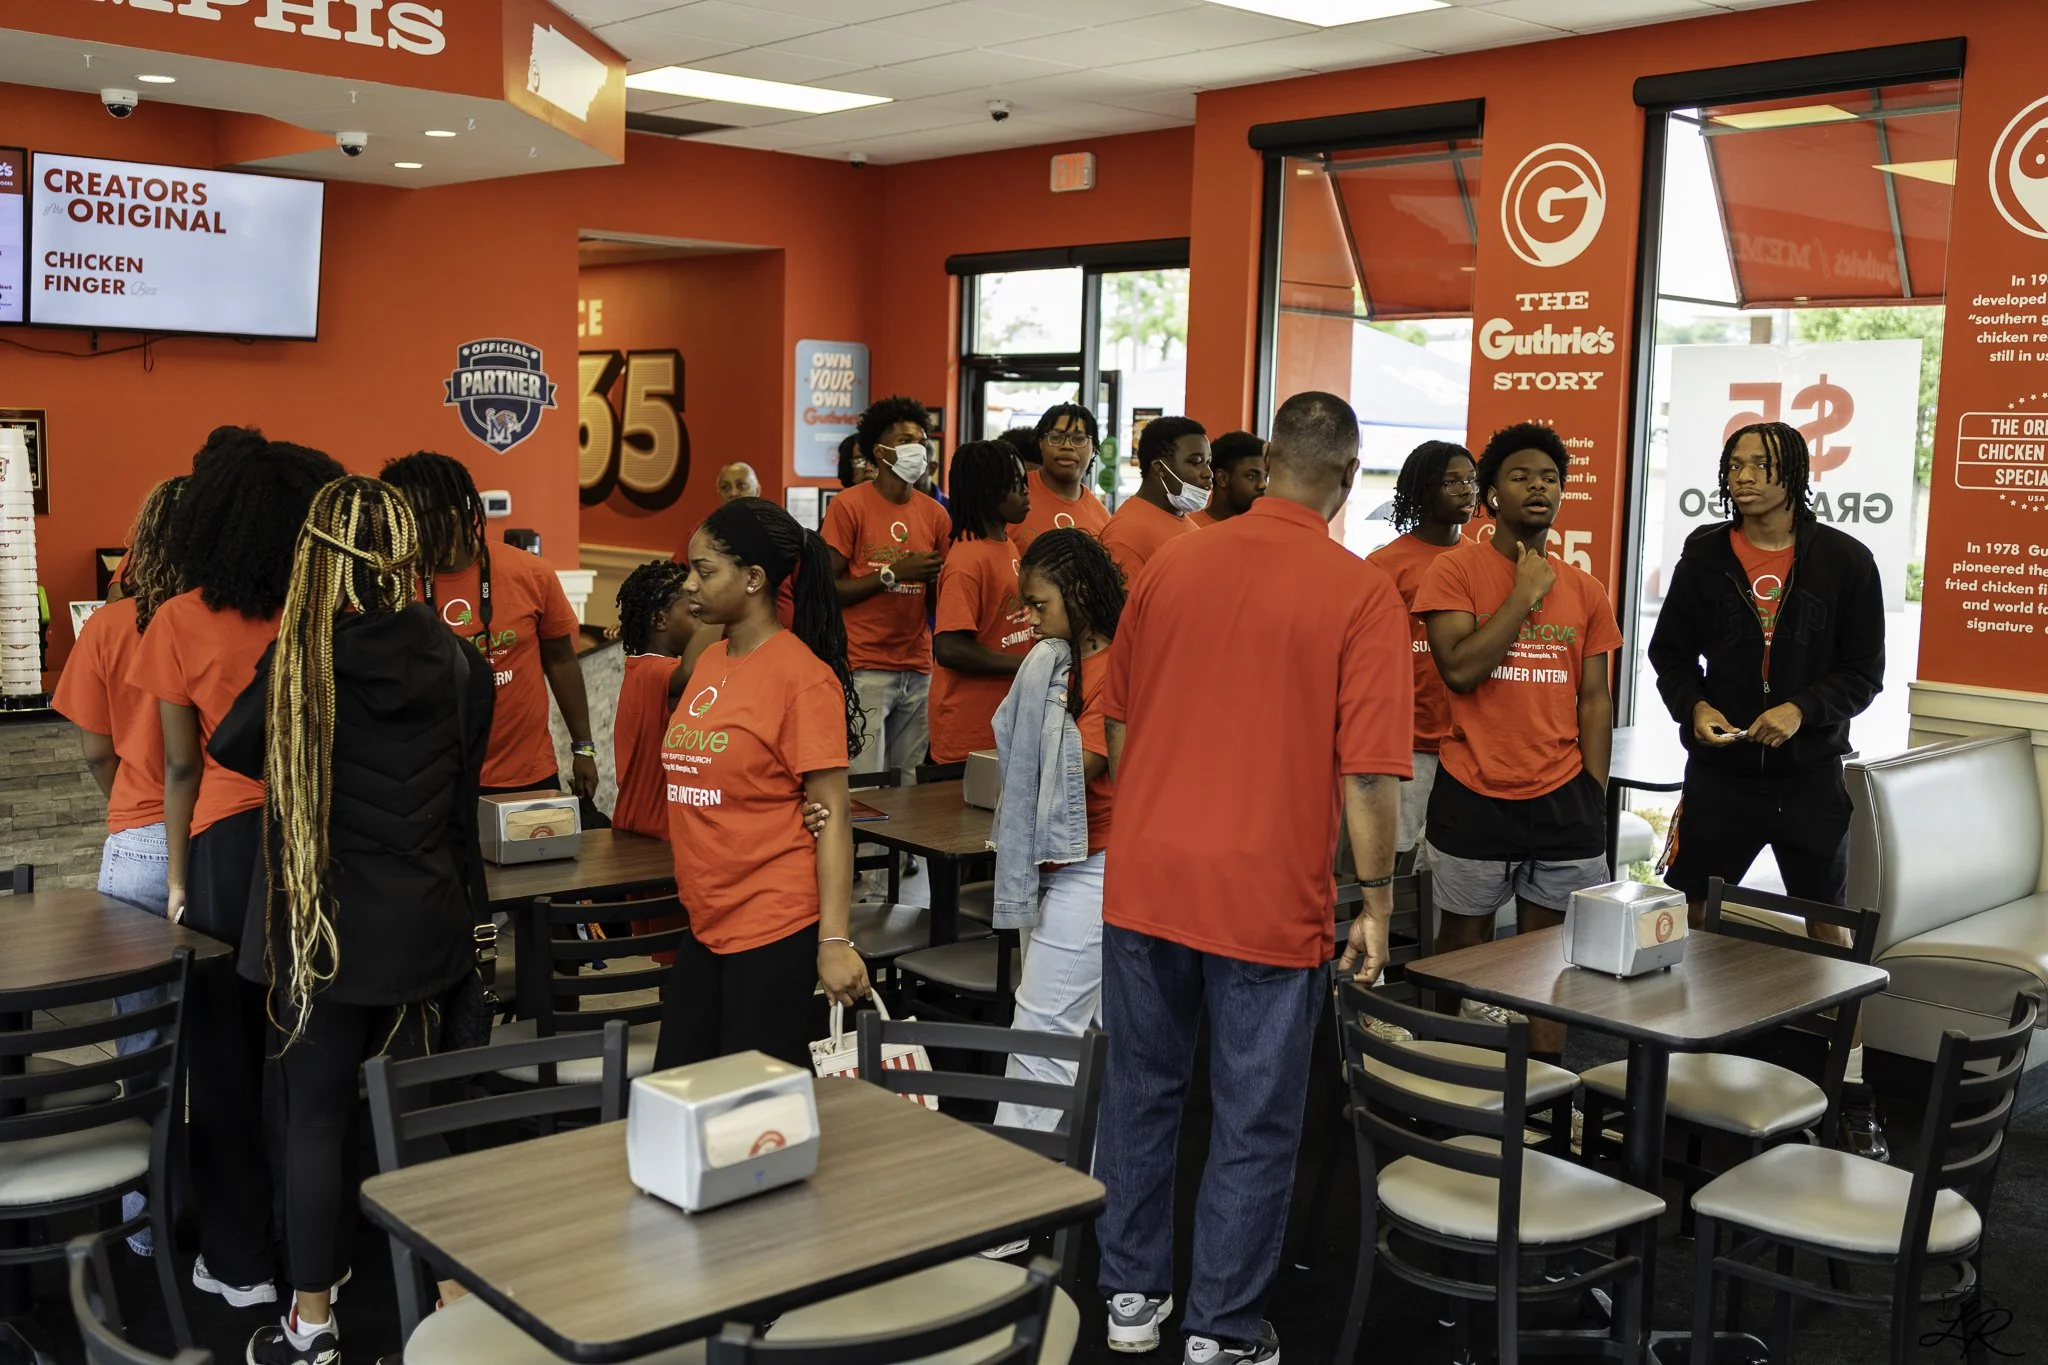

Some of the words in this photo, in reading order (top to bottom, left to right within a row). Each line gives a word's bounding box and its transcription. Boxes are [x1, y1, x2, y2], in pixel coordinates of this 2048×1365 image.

[43, 168, 208, 206] CREATORS
[67, 198, 227, 234] ORIGINAL
[44, 251, 143, 273] CHICKEN
[44, 275, 125, 295] FINGER
[2011, 275, 2025, 286] In
[2031, 274, 2048, 286] 19
[1516, 291, 1589, 311] THE
[1972, 292, 2047, 308] developed
[1479, 318, 1615, 360] Guthrie's
[1976, 331, 2028, 343] chicken
[471, 343, 529, 356] OFFICIAL
[1989, 350, 2014, 362] still
[2018, 350, 2032, 361] in
[812, 352, 853, 368] OWN
[461, 370, 541, 399] PARTNER
[810, 368, 856, 391] YOUR
[1493, 371, 1603, 390] STORY
[812, 391, 852, 408] OWN
[1991, 419, 2019, 435] THE
[1978, 443, 2045, 461] CHICKEN
[1586, 472, 1597, 483] in
[1967, 542, 1981, 554] In
[1986, 543, 2020, 556] 1978
[1952, 561, 2025, 576] pioneered
[2028, 564, 2048, 577] the
[1945, 578, 1978, 592] fried
[1981, 581, 2034, 595] chicken
[1962, 600, 1990, 611] and
[1993, 601, 2034, 614] world
[1967, 618, 2034, 633] signature
[1412, 640, 1431, 652] SU
[1545, 644, 1568, 652] CHURCH
[1532, 668, 1568, 684] INTERN
[685, 755, 712, 764] CHURCH
[679, 785, 722, 807] INTERN
